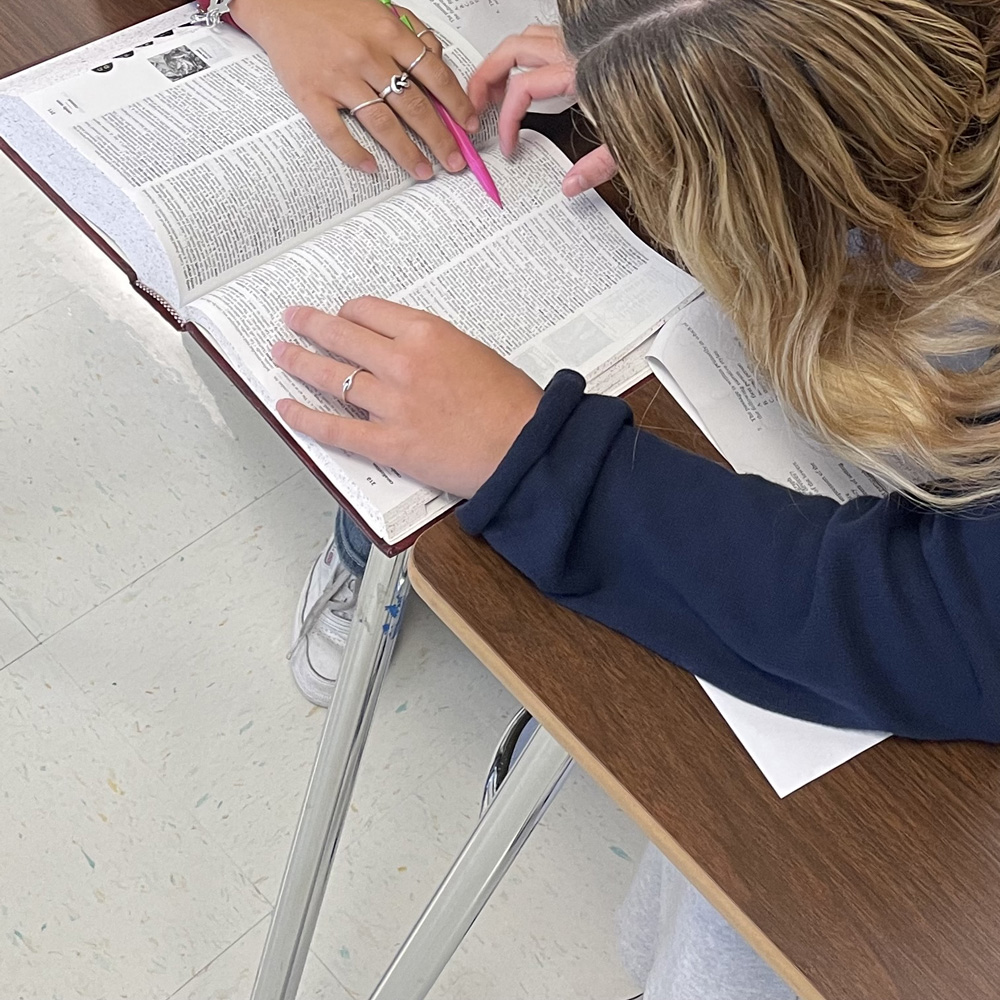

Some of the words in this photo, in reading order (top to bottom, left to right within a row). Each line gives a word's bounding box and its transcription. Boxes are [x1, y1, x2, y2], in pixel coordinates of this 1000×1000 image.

[703, 346, 720, 368] primarily
[723, 365, 740, 385] narrative
[734, 391, 749, 411] passage
[739, 385, 756, 410] following
